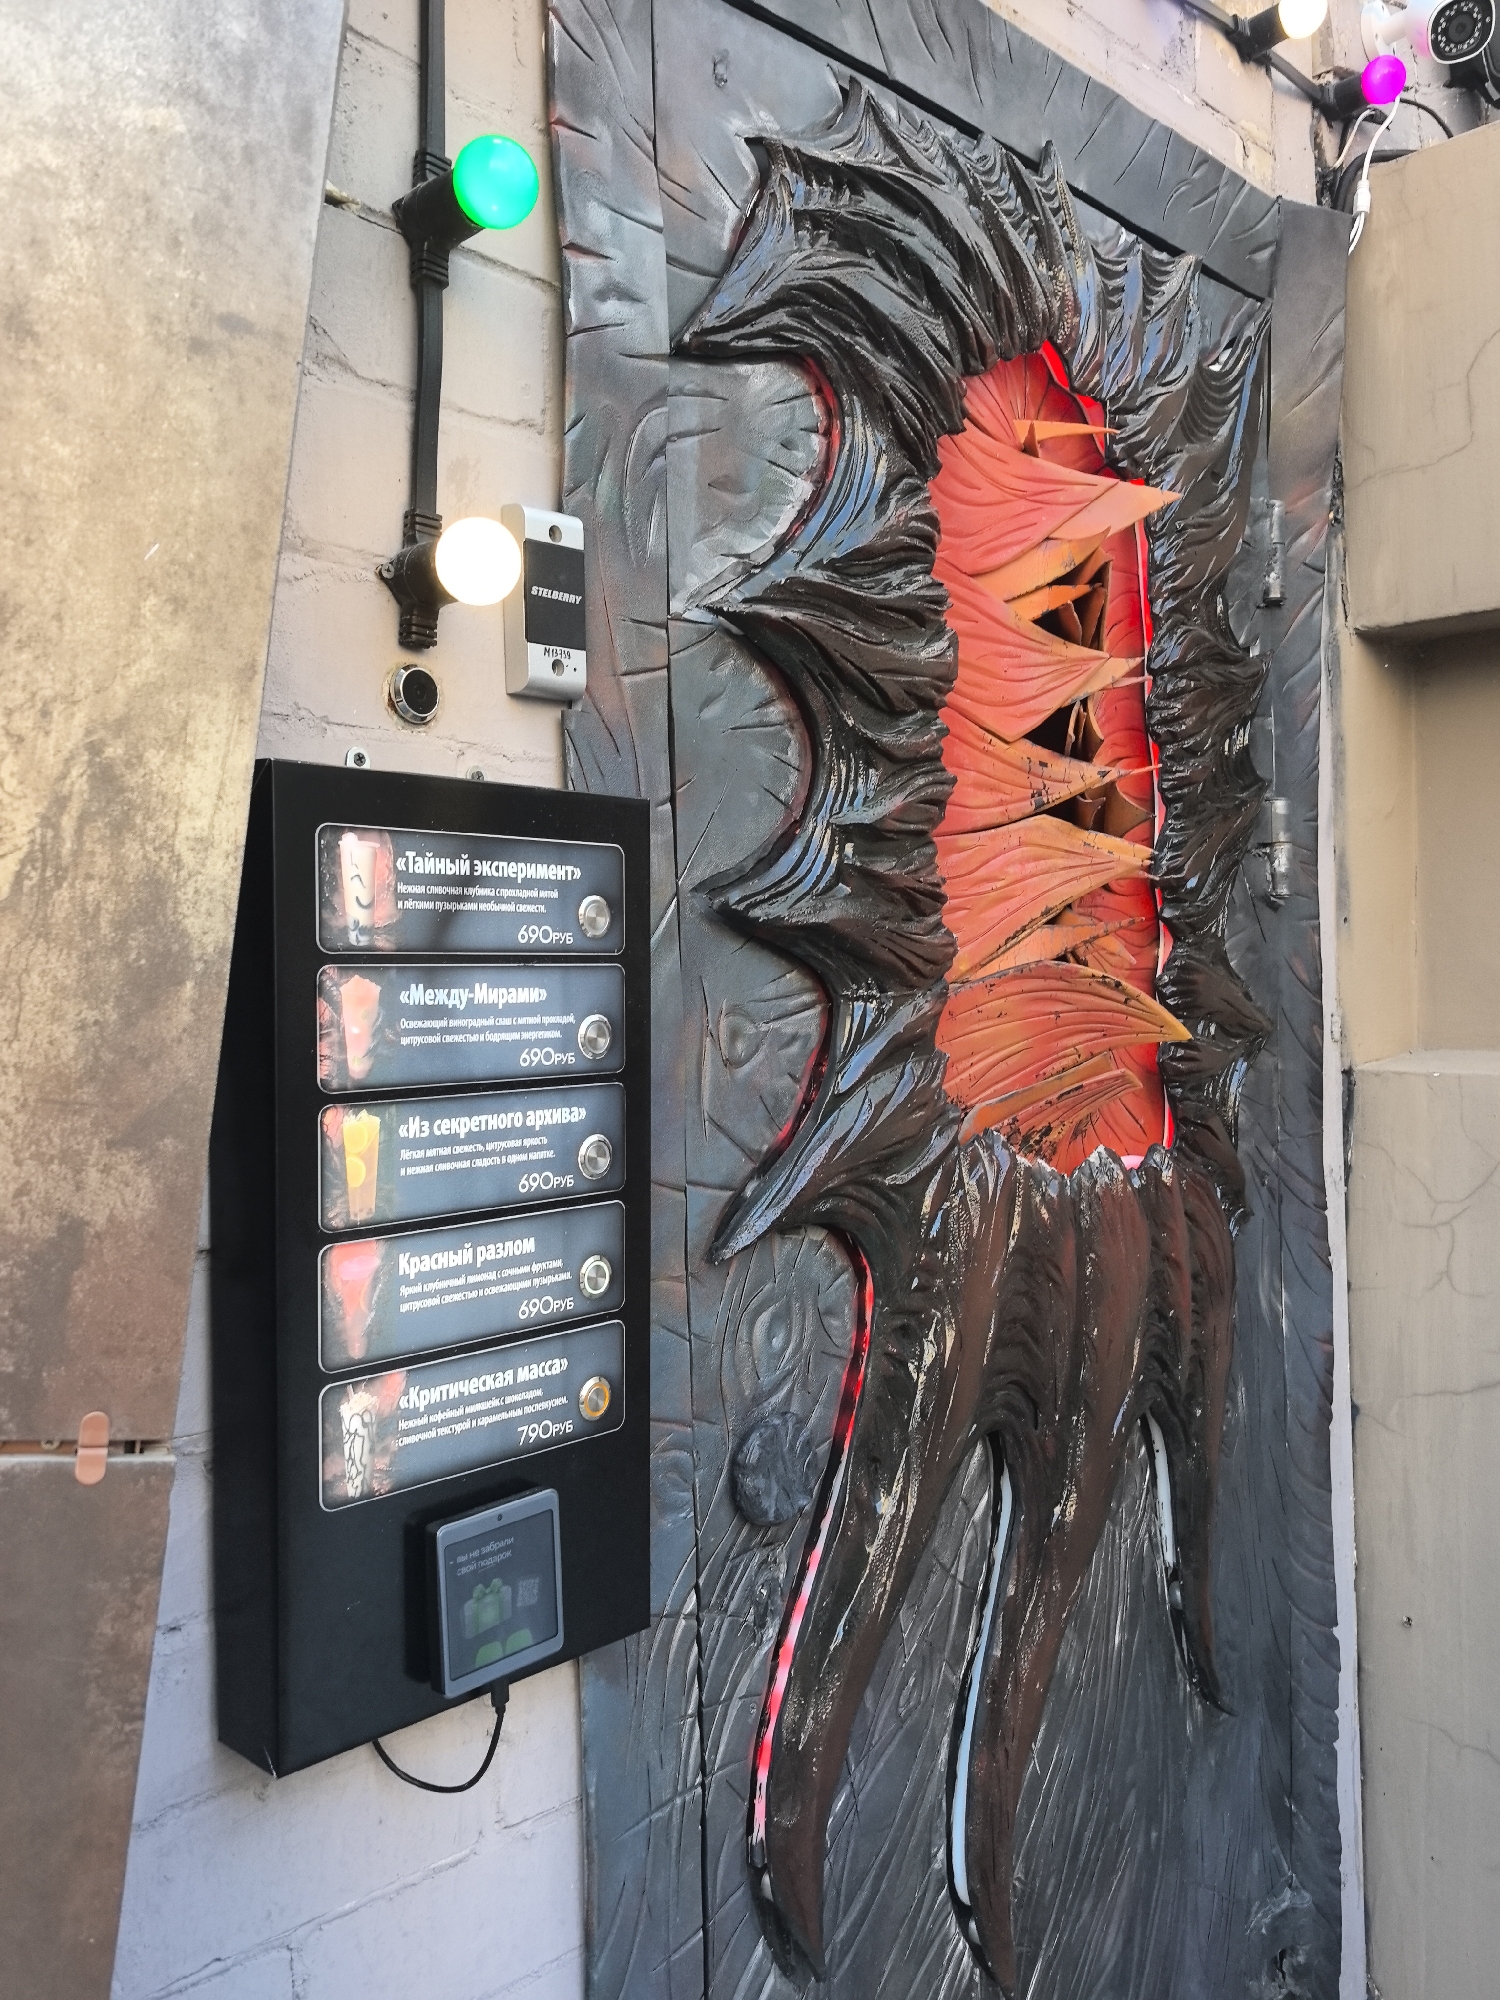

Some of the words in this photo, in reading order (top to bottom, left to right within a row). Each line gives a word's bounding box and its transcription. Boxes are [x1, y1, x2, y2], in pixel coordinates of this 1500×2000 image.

[531, 586, 582, 604] STELBERRY
[396, 851, 470, 875] «Тайный
[474, 859, 581, 883] эксперимент»
[398, 882, 425, 894] Нежная
[426, 884, 462, 895] сливочная
[464, 885, 495, 897] клубника
[496, 888, 499, 896] с
[501, 888, 538, 898] прохладной
[540, 888, 558, 899] мятой
[404, 899, 434, 910] лёгкими
[435, 902, 478, 912] пузырьками
[479, 901, 515, 912] необычной
[516, 904, 547, 913] свежести.
[400, 983, 547, 1010] «Между-Мирами»
[401, 1017, 447, 1029] Освежающий
[449, 1016, 494, 1028] виноградный
[495, 1017, 512, 1025] слаш
[518, 1014, 540, 1024] мятной
[542, 1013, 575, 1025] прохладой,
[401, 1033, 440, 1046] цитрусовой
[442, 1032, 479, 1042] свежестью
[485, 1031, 520, 1042] бодрящим
[521, 1030, 562, 1040] энергетиком.
[399, 1116, 430, 1138] «Из
[434, 1112, 522, 1138] секретного
[526, 1107, 586, 1130] архива»
[400, 1149, 424, 1160] Лёгкая
[426, 1147, 451, 1157] мятная
[453, 1144, 484, 1155] свежесть,
[486, 1139, 522, 1152] цитрусовая
[523, 1136, 547, 1147] яркость
[401, 1167, 405, 1176] и
[407, 1163, 433, 1174] нежная
[435, 1158, 470, 1171] сливочная
[472, 1155, 500, 1167] сладость
[507, 1153, 527, 1164] одном
[529, 1150, 555, 1160] напитке.
[399, 1243, 473, 1279] Красный
[477, 1237, 535, 1267] разлом
[400, 1283, 422, 1297] Яркий
[424, 1276, 465, 1292] клубничный
[467, 1271, 496, 1284] лимонад
[502, 1266, 530, 1276] сочными
[400, 1296, 440, 1313] цитрусовой
[441, 1289, 478, 1304] свежестью
[479, 1288, 483, 1296] и
[485, 1278, 531, 1296] освежающими
[533, 1271, 572, 1288] пузырьками.
[399, 1370, 513, 1412] «Критическая
[517, 1358, 568, 1382] масса»
[399, 1416, 428, 1431] Нежный
[430, 1406, 464, 1423] кофейный
[465, 1400, 499, 1414] милкшейк
[399, 1427, 436, 1446] сливочной
[437, 1420, 470, 1436] текстурой
[472, 1418, 476, 1427] и
[477, 1407, 522, 1426] карамельным
[524, 1396, 568, 1414] послевкусием.
[456, 1553, 468, 1563] вы
[469, 1550, 479, 1560] не
[481, 1537, 514, 1555] забрали
[457, 1562, 477, 1575] свой
[478, 1550, 512, 1568] подарок
